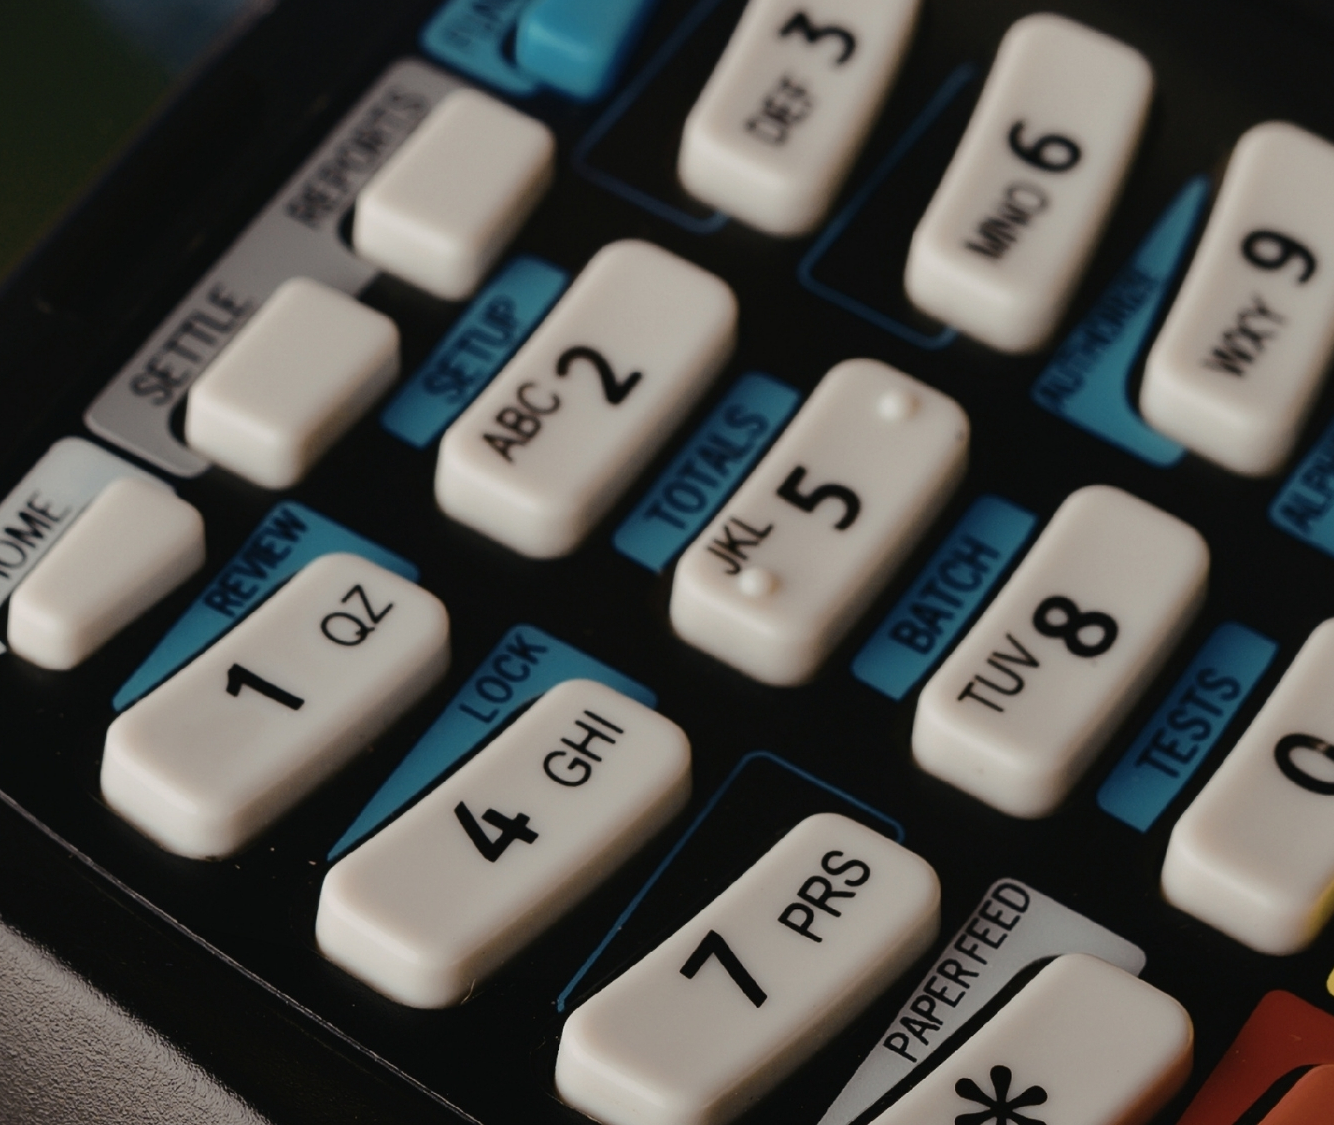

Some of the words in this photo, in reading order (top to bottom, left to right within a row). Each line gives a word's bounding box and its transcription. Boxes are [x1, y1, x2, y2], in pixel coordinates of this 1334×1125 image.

[777, 9, 858, 66] 3
[285, 87, 431, 229] REPORTS
[743, 73, 816, 147] DEF
[1006, 119, 1083, 175] 6
[964, 181, 1051, 262] MNO
[1239, 228, 1318, 286] 9
[129, 282, 254, 407] SETTLE
[422, 295, 517, 404] SETUP
[1201, 293, 1291, 380] WXY
[481, 381, 562, 464] ABC
[557, 345, 643, 406] 2
[643, 403, 769, 531] TOTALS
[705, 515, 774, 575] JKL
[776, 465, 862, 531] 5
[204, 508, 309, 618] REVIEW
[889, 535, 1000, 655] BATCH
[225, 663, 305, 711] 1
[320, 584, 394, 646] QZ
[458, 632, 548, 725] LOCK
[957, 632, 1040, 714] TUV
[1032, 595, 1119, 659] 8
[1134, 667, 1242, 779] TESTS
[454, 801, 539, 863] 4
[543, 710, 624, 787] GHI
[679, 930, 768, 1008] 7
[778, 850, 871, 943] PRS
